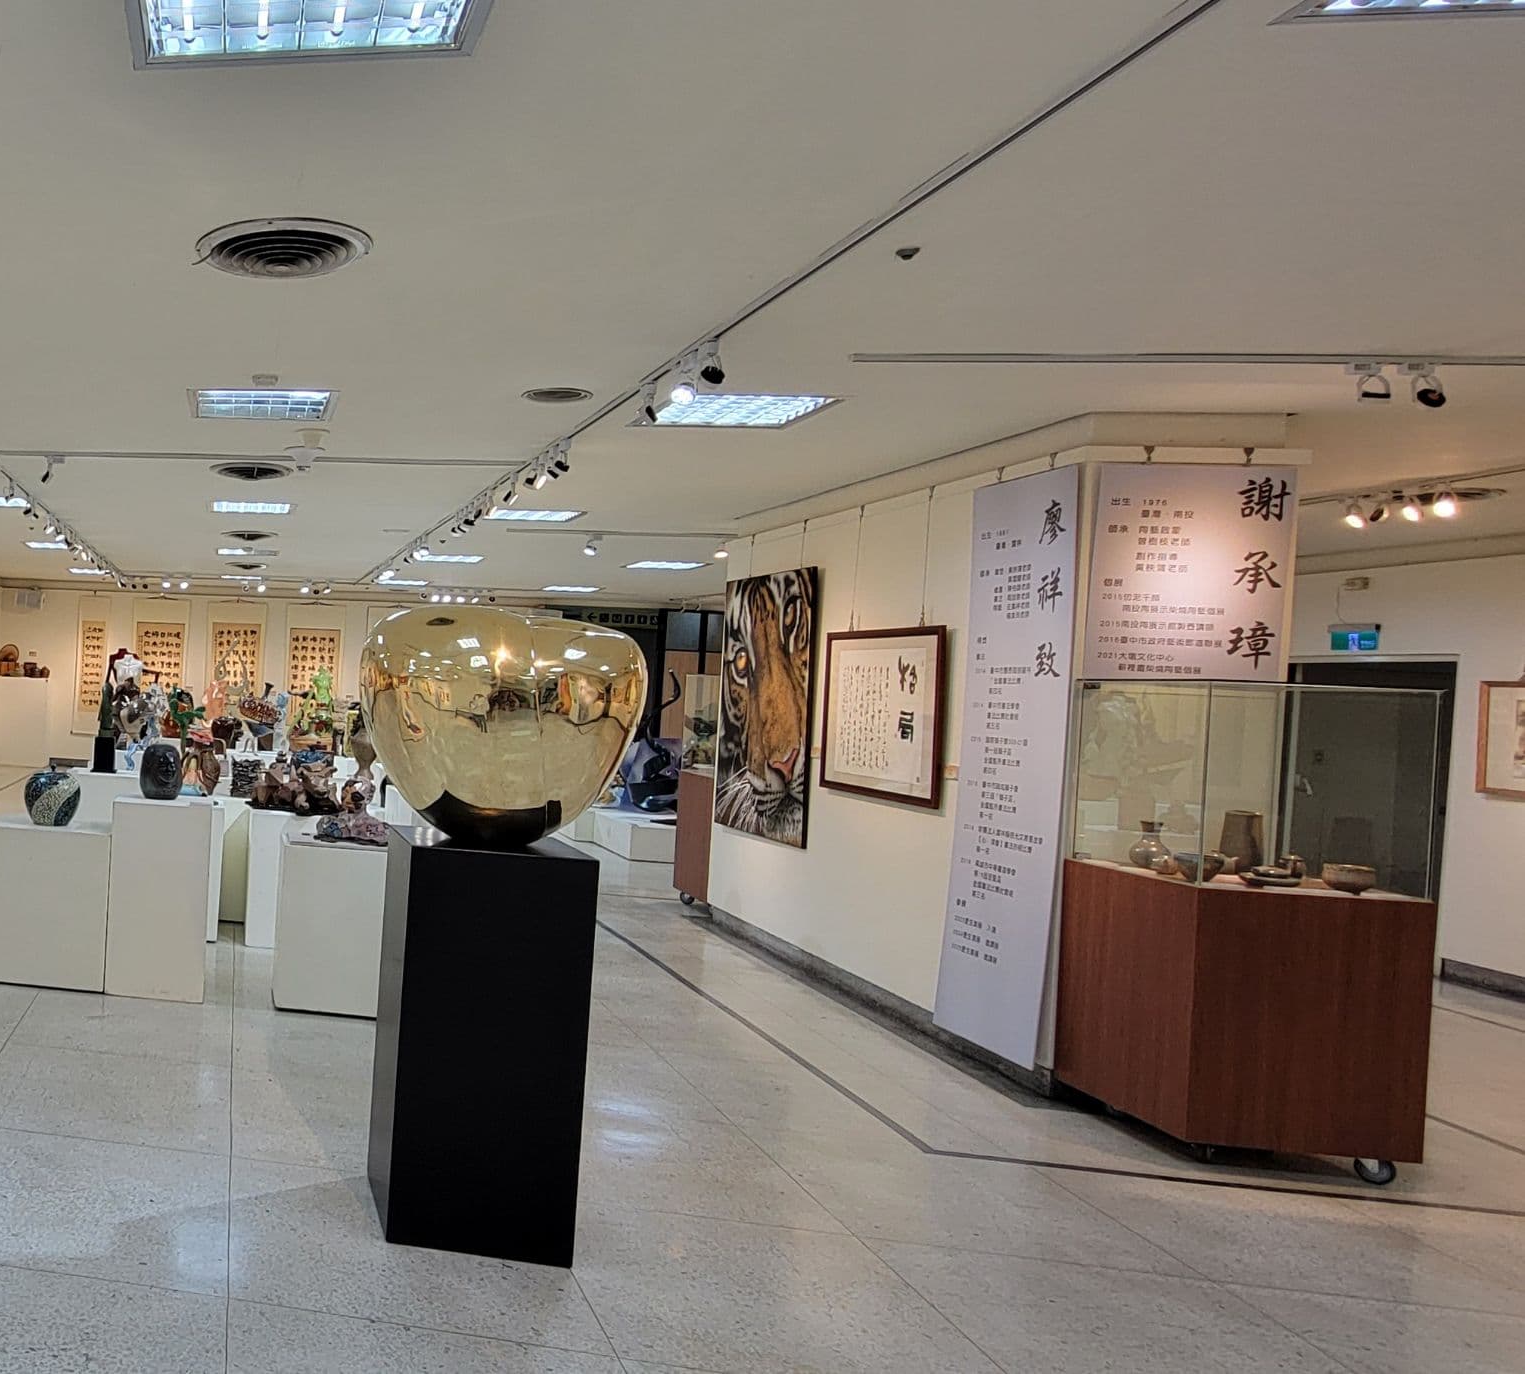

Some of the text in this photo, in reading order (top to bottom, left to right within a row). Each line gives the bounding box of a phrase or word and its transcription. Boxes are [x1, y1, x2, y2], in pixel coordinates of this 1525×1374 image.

[1033, 499, 1067, 677] 廖祥致
[1226, 476, 1292, 670] 謝承璋
